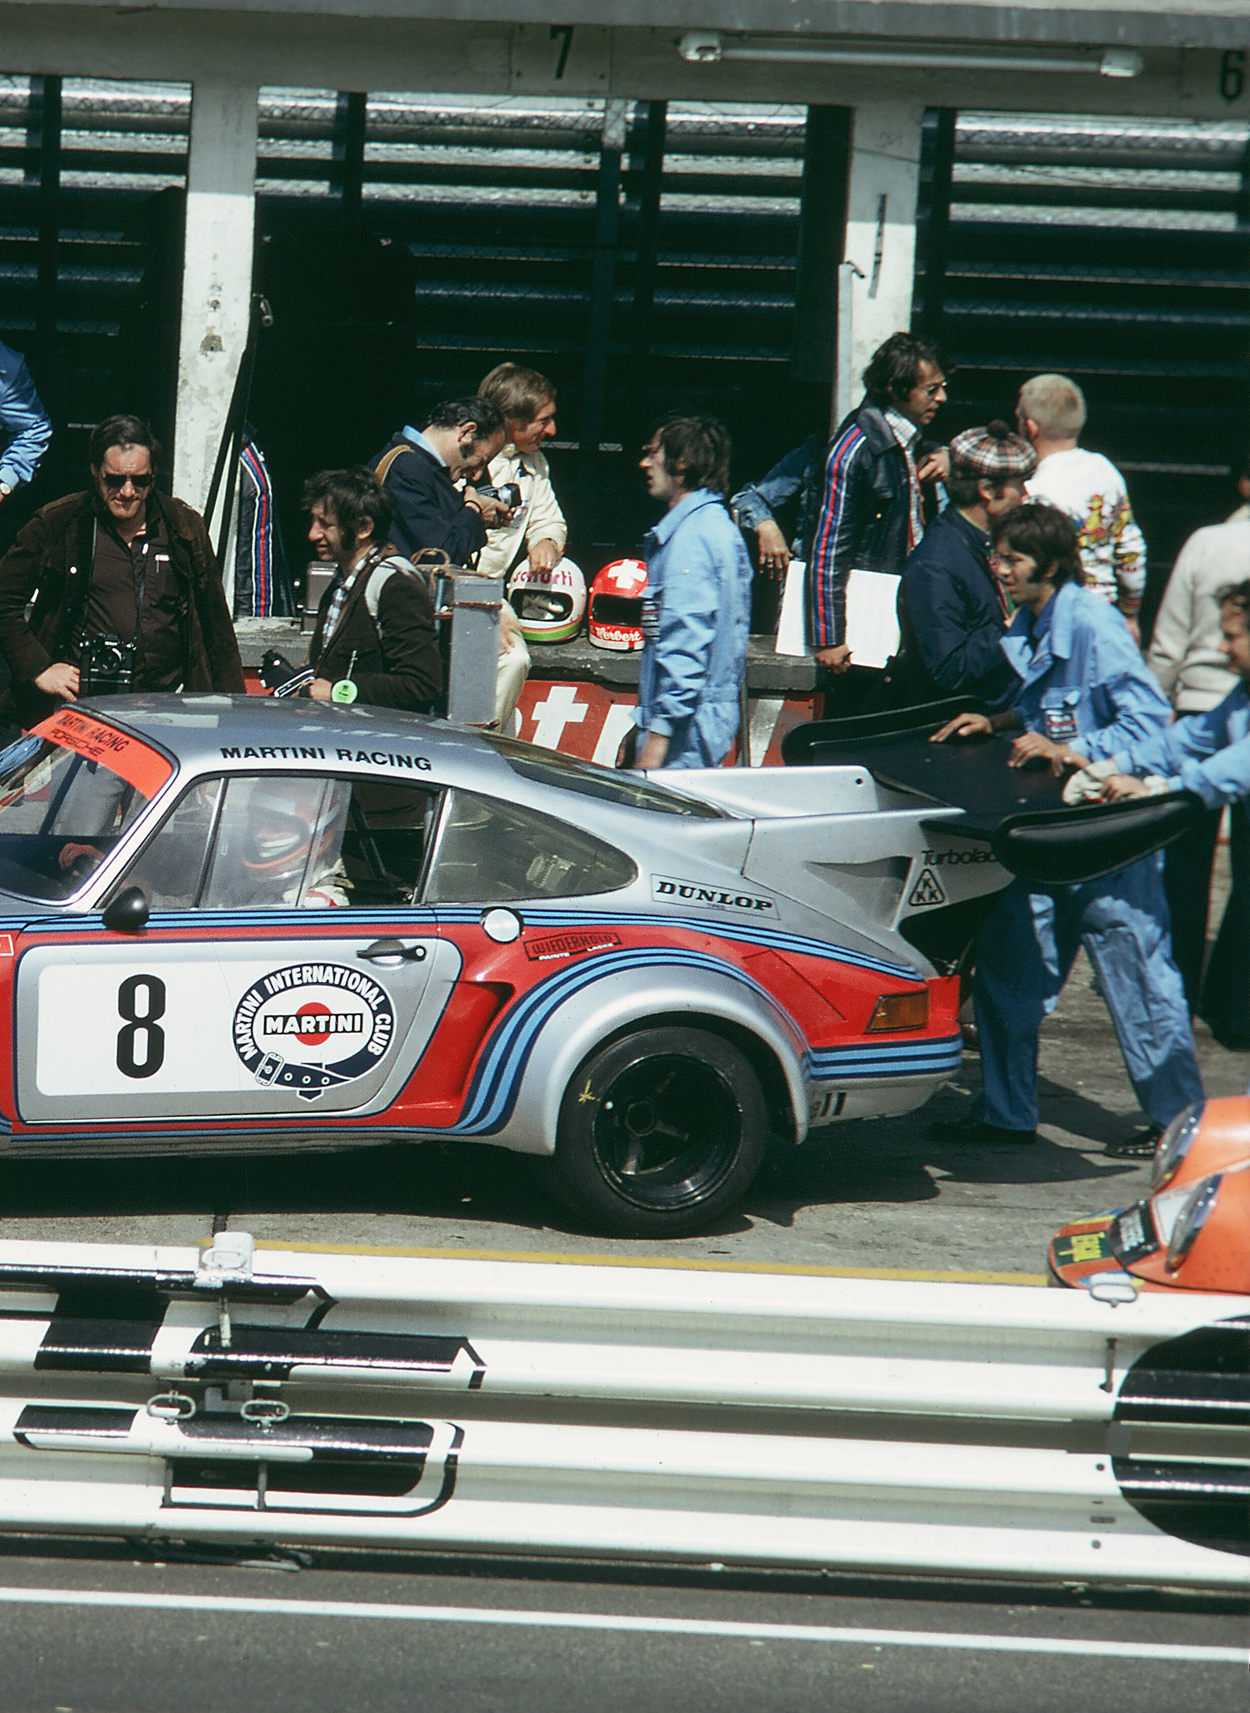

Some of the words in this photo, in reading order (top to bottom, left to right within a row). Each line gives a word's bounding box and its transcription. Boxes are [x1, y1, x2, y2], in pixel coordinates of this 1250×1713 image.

[550, 25, 573, 79] 7
[1221, 51, 1243, 101] 6
[595, 628, 643, 641] Herbert
[51, 728, 105, 757] PORSCHE
[91, 727, 130, 752] RACING
[220, 747, 326, 759] MARTINI
[335, 748, 432, 771] RACING
[656, 880, 772, 911] DUNLOP
[531, 934, 613, 955] WIEDERHOLD
[116, 973, 166, 1079] 8
[234, 989, 264, 1061] MARTINI
[263, 965, 385, 1011] INTERNATIONAL
[367, 1013, 392, 1056] CLUB
[265, 1014, 362, 1034] MARTINI
